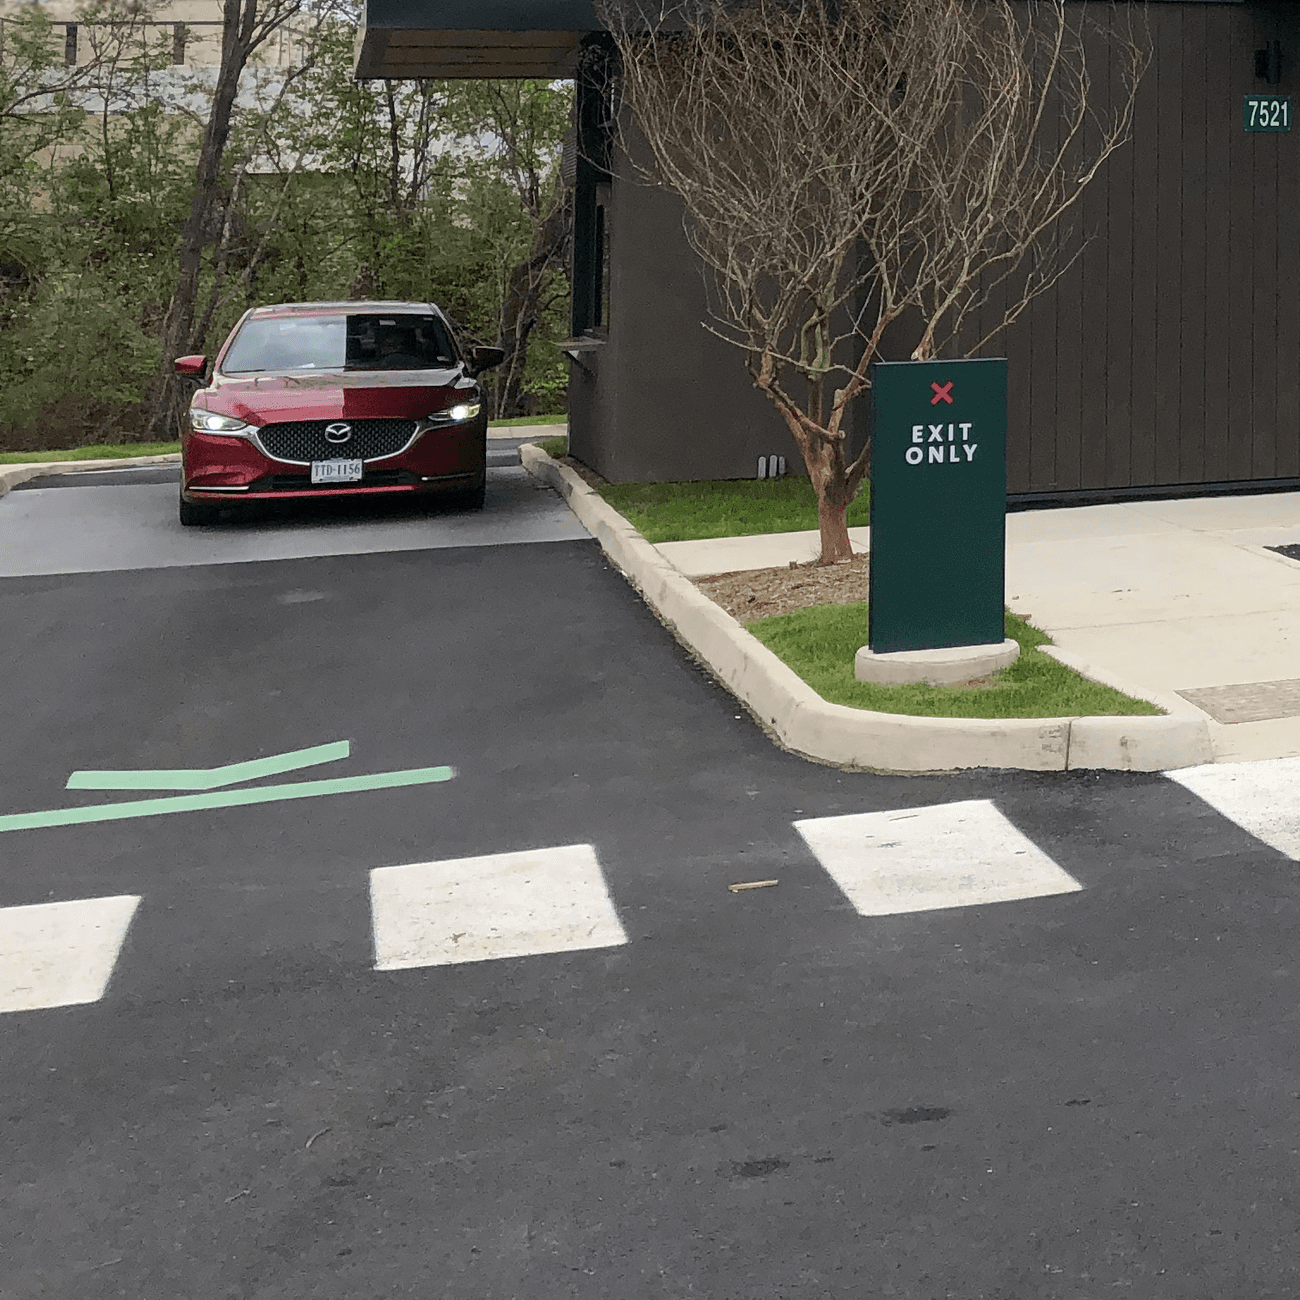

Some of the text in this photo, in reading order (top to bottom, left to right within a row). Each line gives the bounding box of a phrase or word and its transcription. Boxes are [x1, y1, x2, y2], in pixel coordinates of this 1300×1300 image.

[1248, 100, 1288, 127] 7521
[912, 423, 972, 443] EXIT
[905, 444, 978, 465] ONLY
